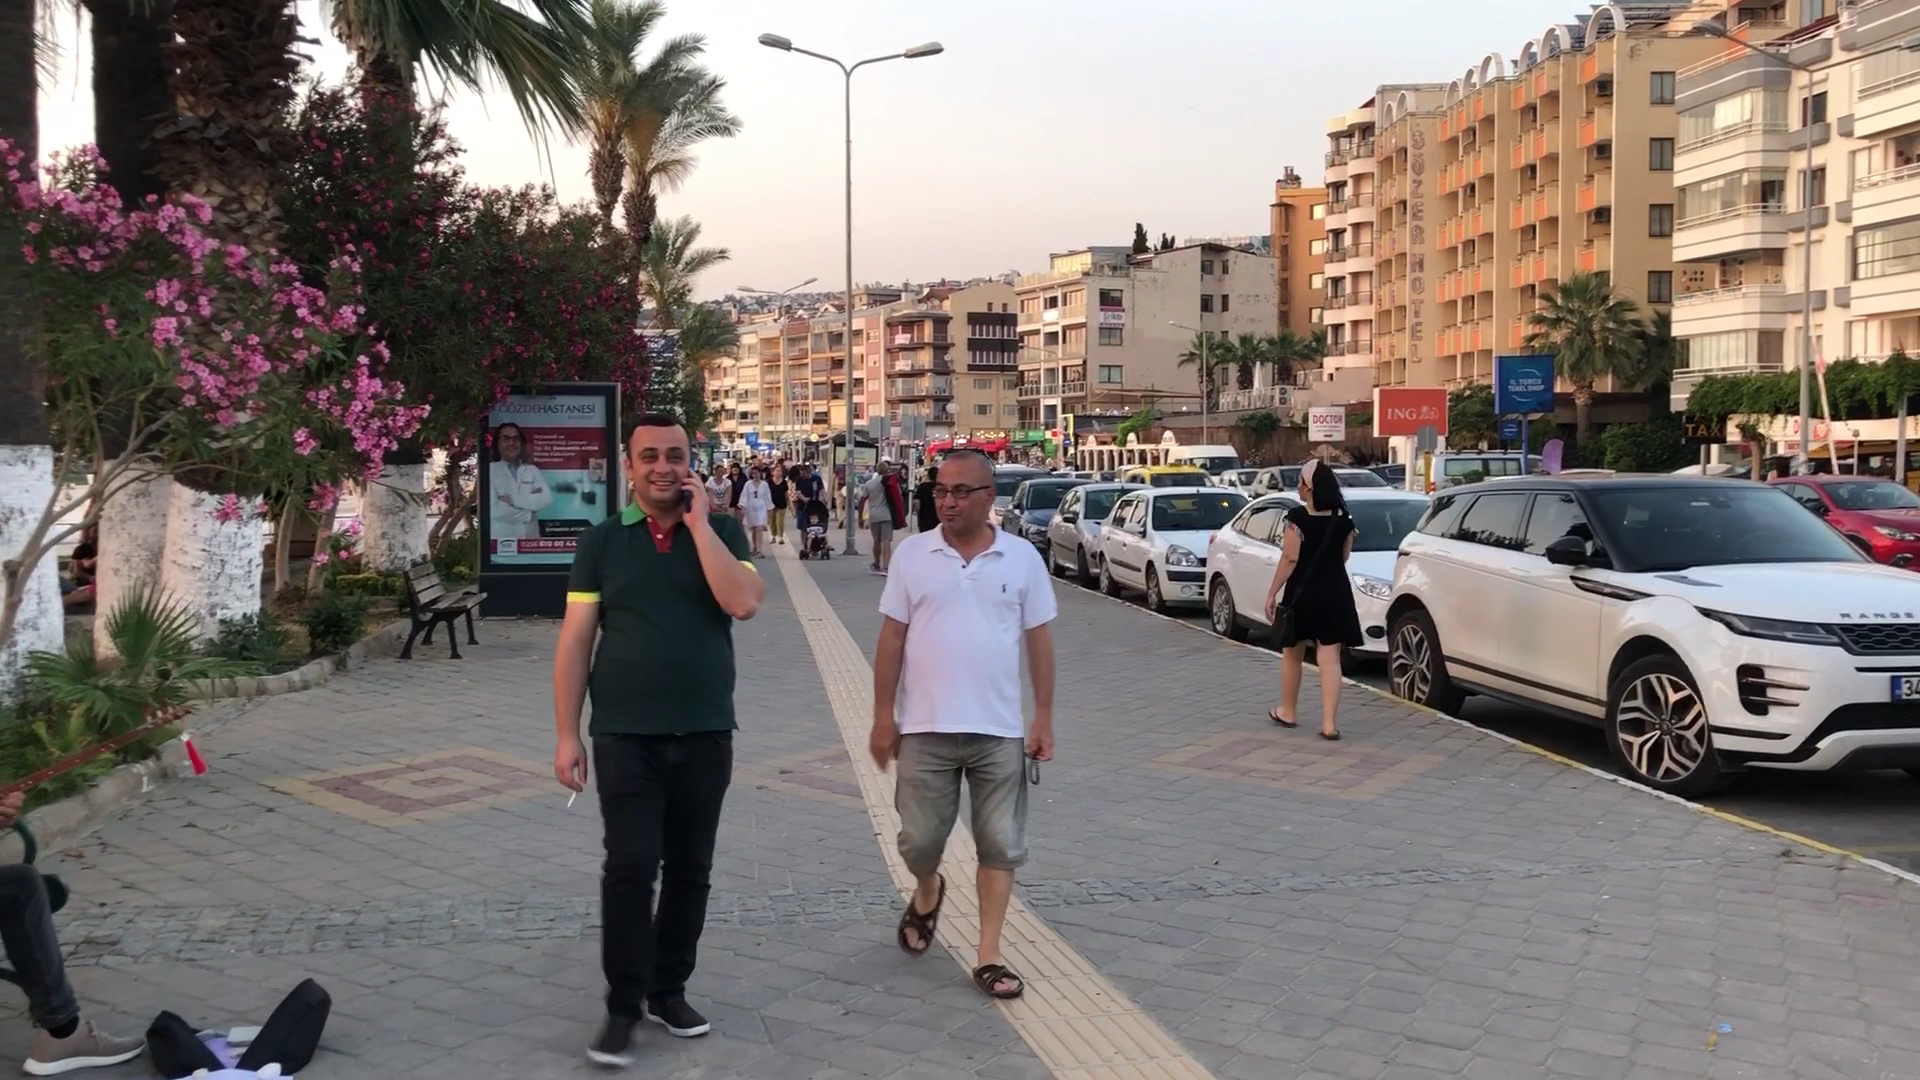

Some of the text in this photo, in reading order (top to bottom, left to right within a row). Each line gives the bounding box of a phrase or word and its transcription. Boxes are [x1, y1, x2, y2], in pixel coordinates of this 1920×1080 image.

[1411, 253, 1425, 364] HOTEL
[1313, 414, 1343, 424] DOCTOR
[1387, 408, 1417, 420] ING
